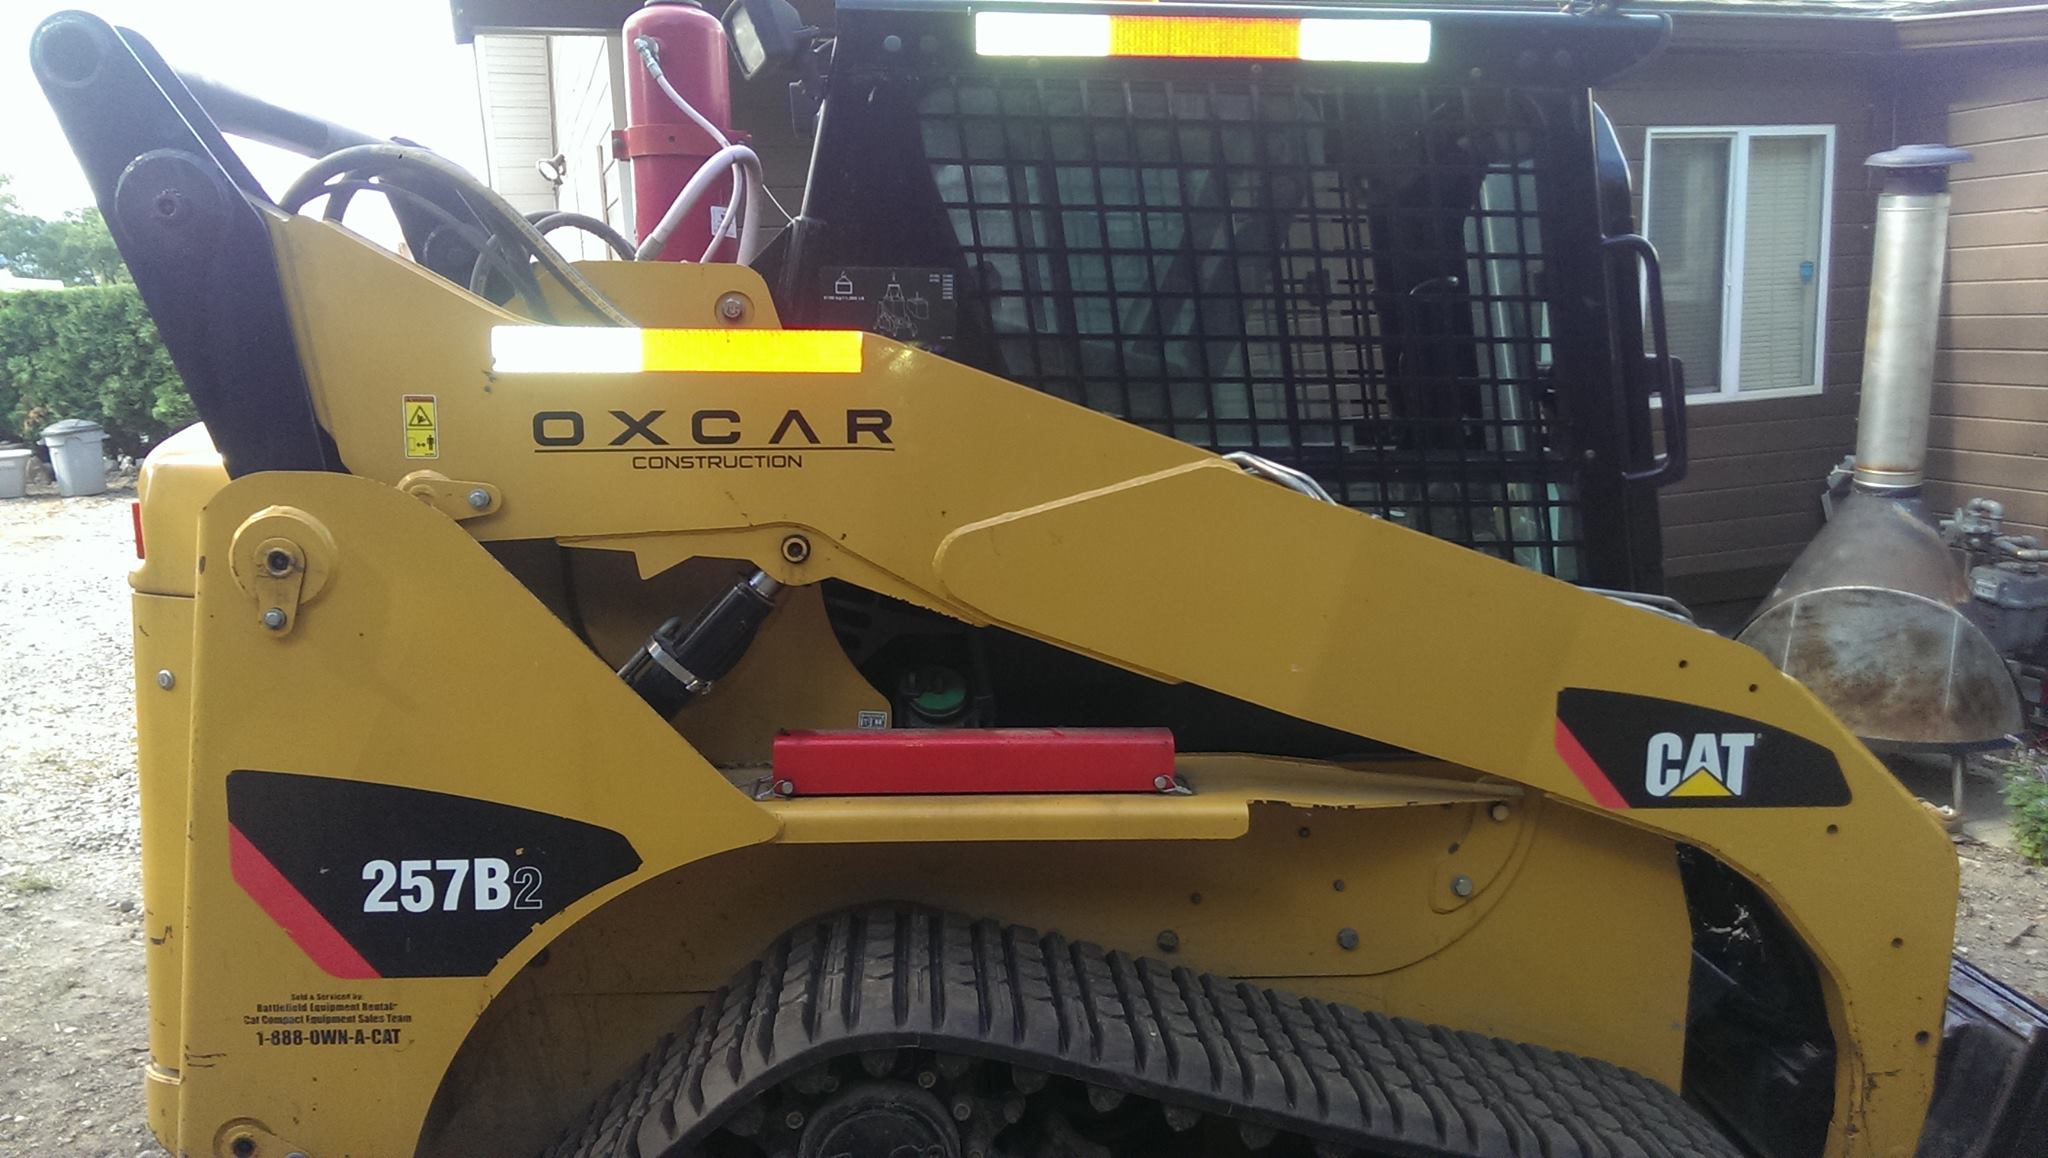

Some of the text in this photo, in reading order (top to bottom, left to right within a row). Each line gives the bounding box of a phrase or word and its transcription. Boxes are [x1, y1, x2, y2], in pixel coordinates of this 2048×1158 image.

[532, 409, 894, 447] OXCAR
[632, 455, 803, 470] CONSTRUCTION
[1645, 732, 1757, 797] CAT
[362, 857, 543, 913] 257B2
[256, 1003, 308, 1013] Battlefield
[309, 1002, 360, 1013] Equipment
[243, 1013, 412, 1026] Cat Compact Equipment Sales Team
[255, 1028, 402, 1046] 1-888-OWN-A-CAT
